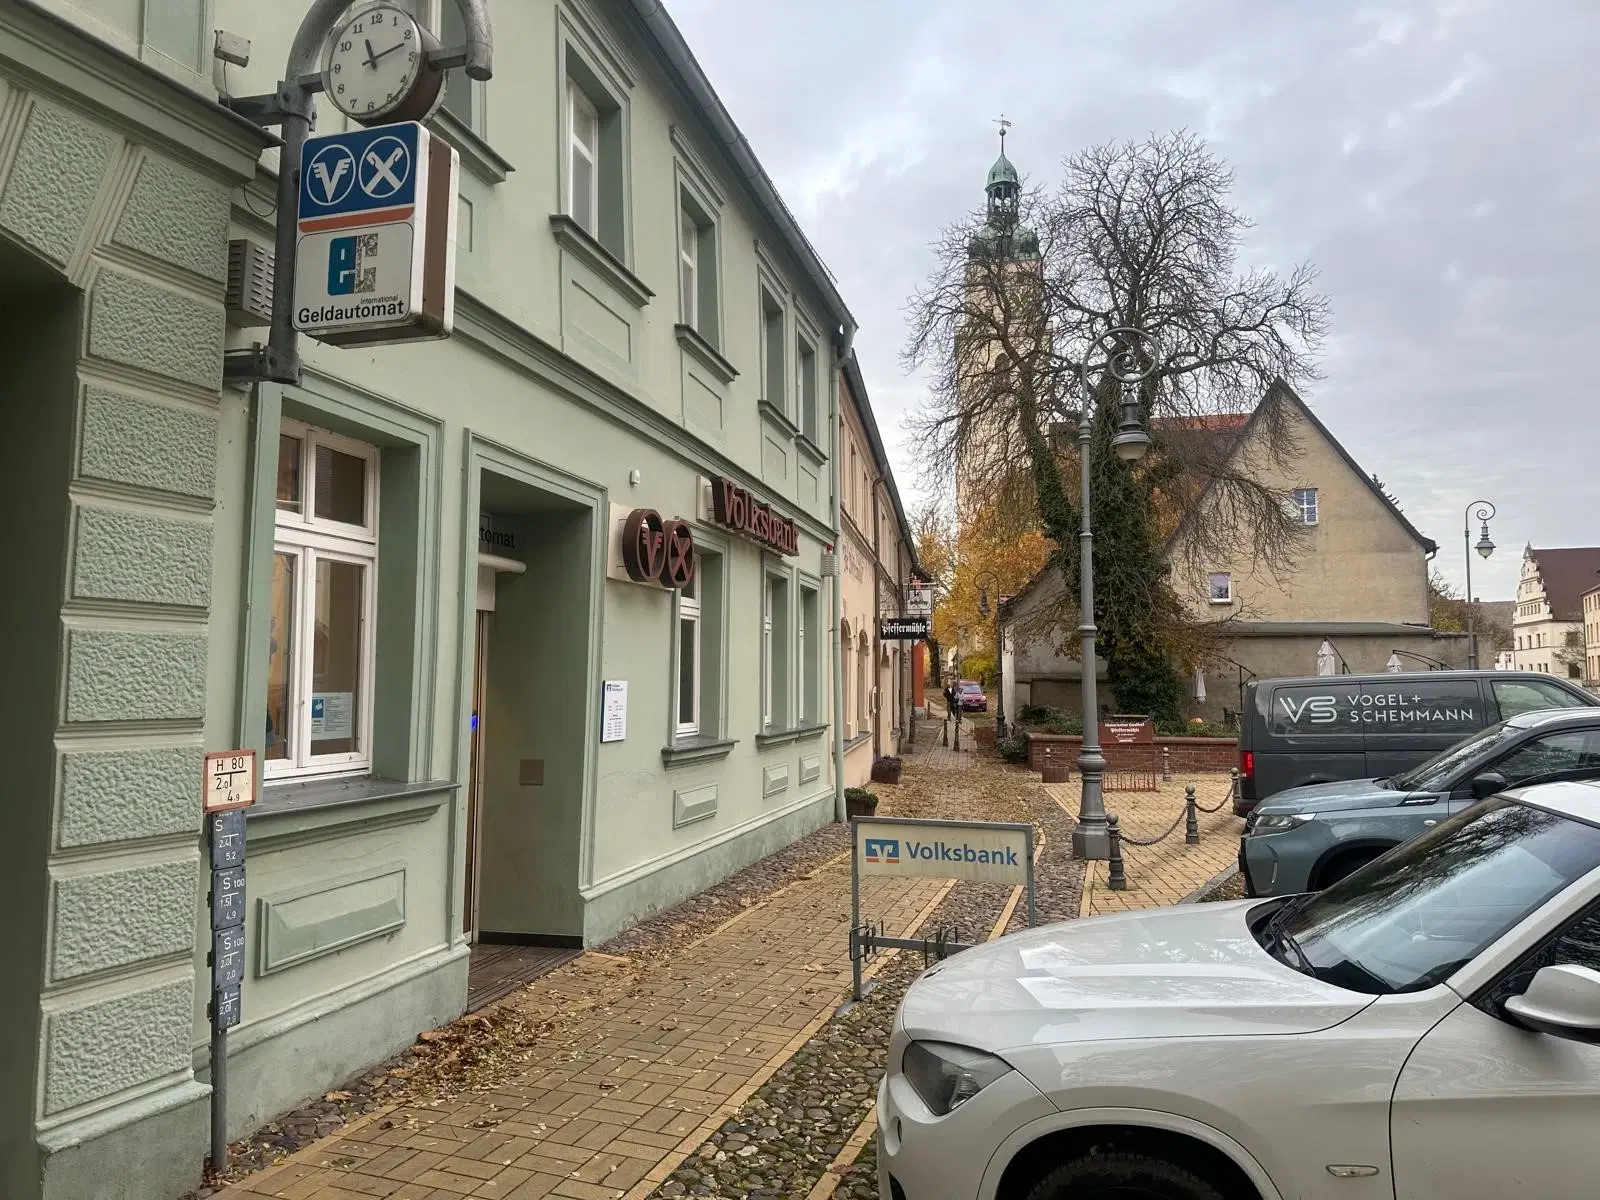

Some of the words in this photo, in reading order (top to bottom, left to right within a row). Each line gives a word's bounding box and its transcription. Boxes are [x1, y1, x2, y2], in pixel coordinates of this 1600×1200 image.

[370, 13, 383, 25] 12
[392, 16, 398, 27] 1
[352, 24, 364, 34] 11
[403, 29, 412, 40] 2
[340, 40, 352, 52] 10
[334, 63, 341, 74] 9
[400, 75, 407, 84] 4
[337, 83, 345, 94] 8
[349, 99, 357, 109] 7
[367, 101, 375, 111] 6
[360, 294, 399, 304] International
[298, 300, 404, 324] Geldautomat
[720, 475, 799, 557] Volksbank
[1347, 694, 1408, 706] VOGEL
[1350, 708, 1473, 723] SCHEMMANN
[216, 759, 224, 771] H
[231, 756, 244, 770] 80
[215, 777, 229, 790] 2.0
[227, 790, 240, 803] 4.9
[215, 819, 224, 832] S
[905, 841, 1018, 866] Volksbank
[223, 877, 231, 890] S
[233, 878, 245, 888] 100
[223, 936, 231, 950] S
[233, 936, 245, 948] 100
